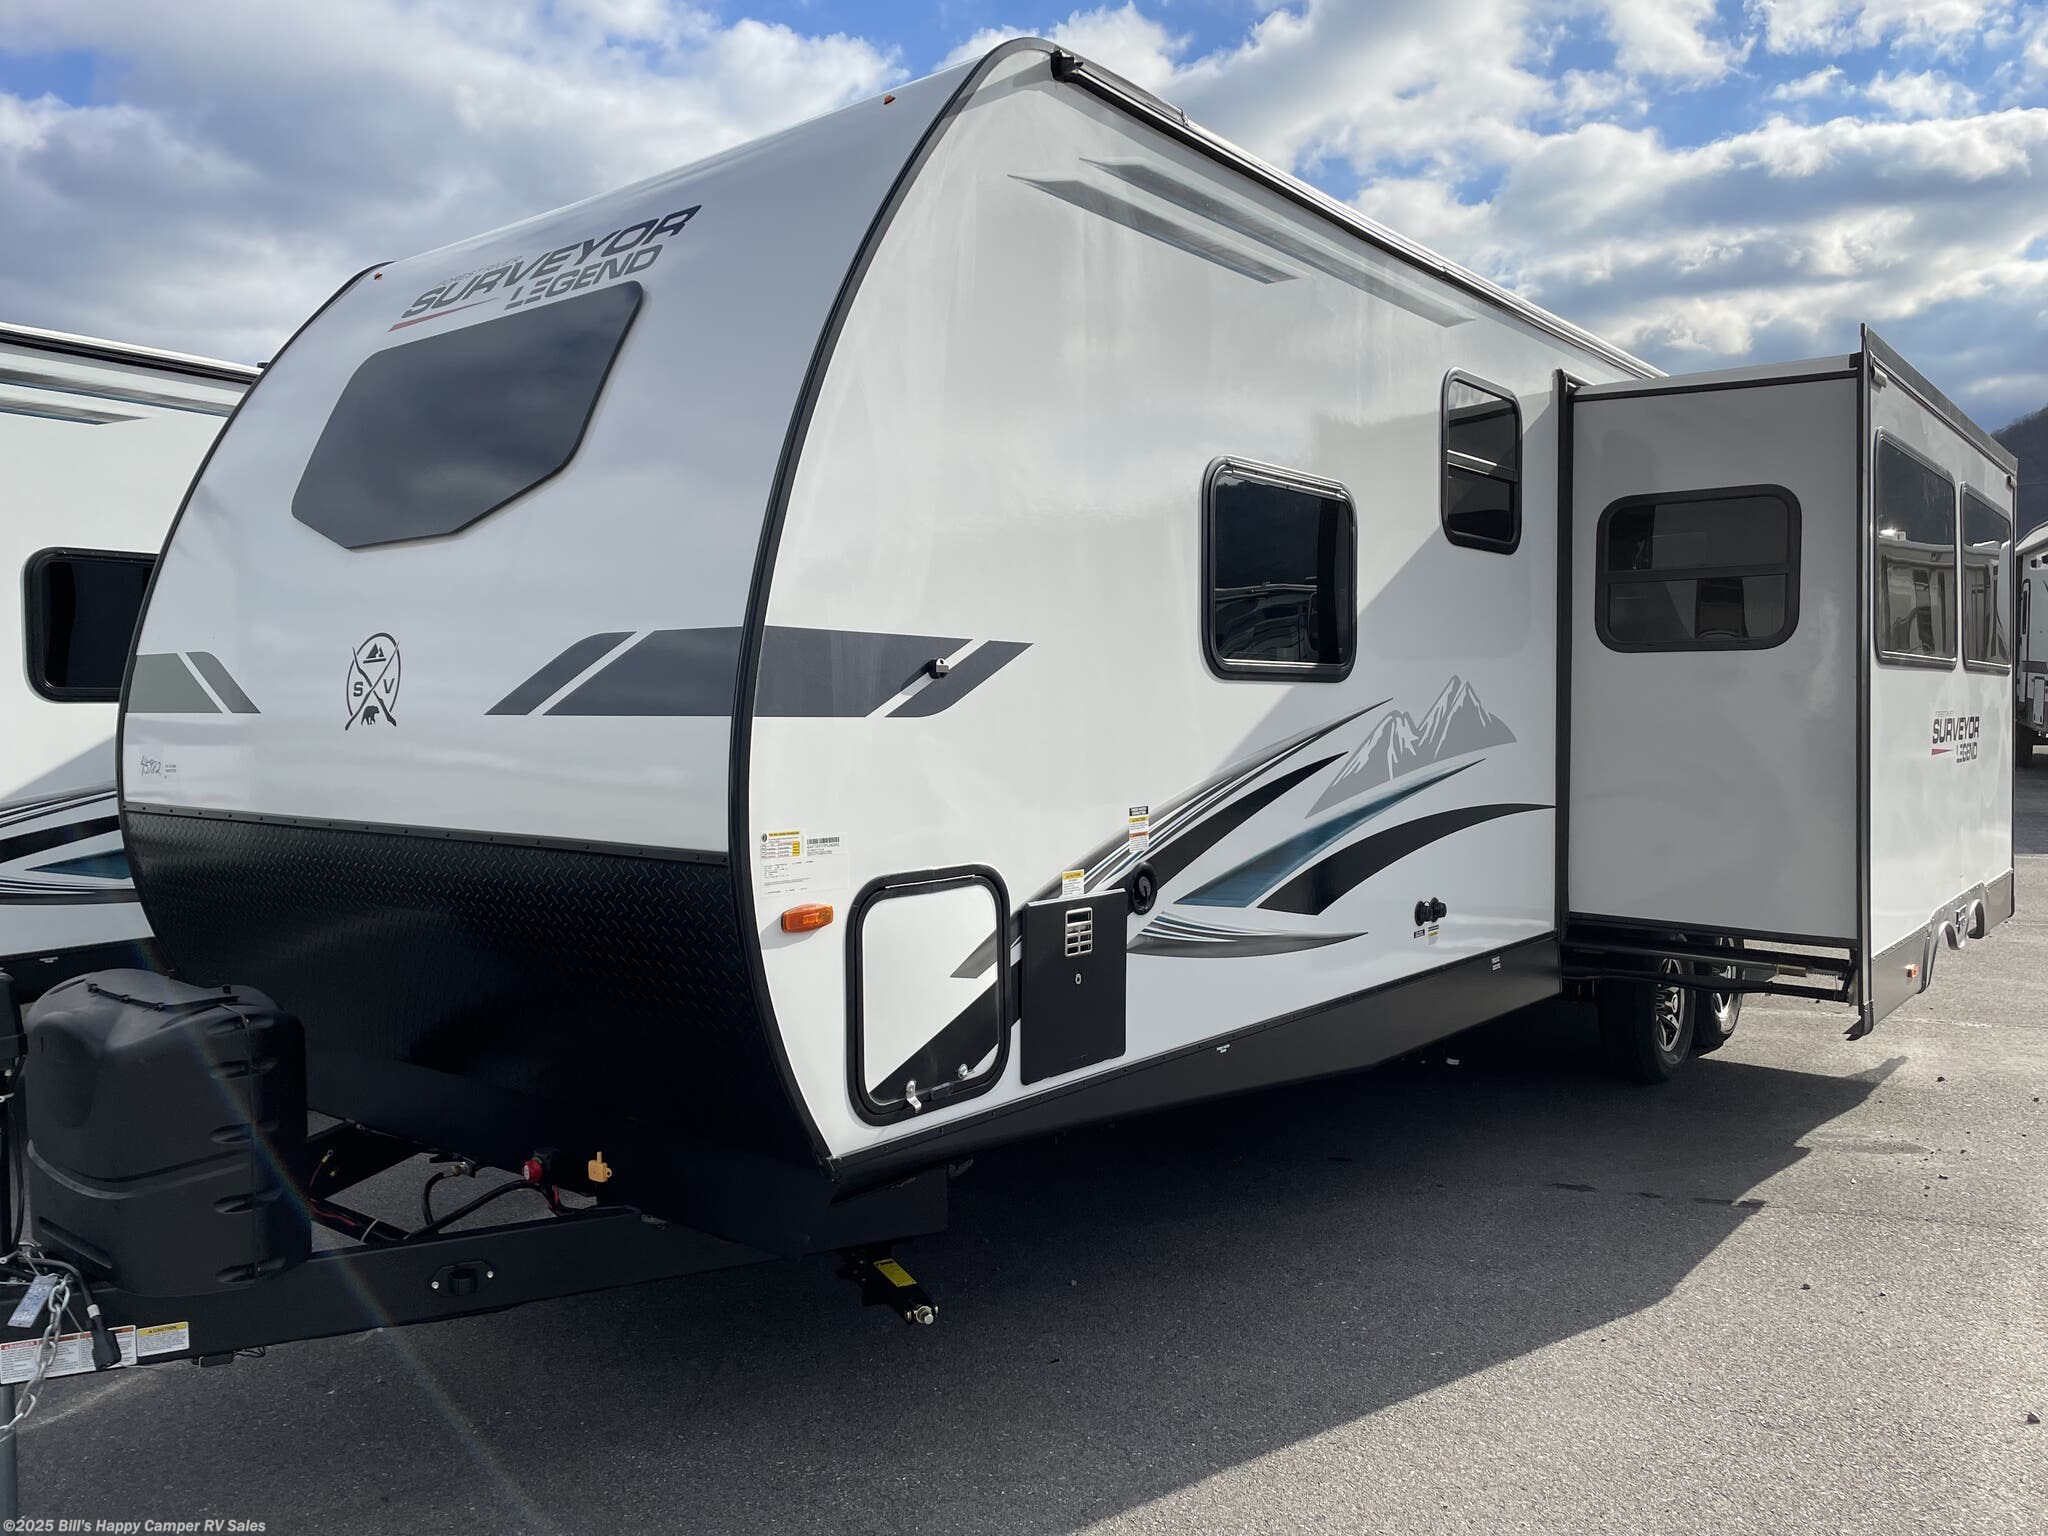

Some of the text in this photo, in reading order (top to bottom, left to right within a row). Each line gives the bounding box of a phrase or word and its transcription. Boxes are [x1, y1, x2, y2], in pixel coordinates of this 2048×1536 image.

[401, 204, 702, 319] SURVEYOR
[504, 243, 664, 311] LEGEND
[353, 677, 395, 697] S V
[1932, 716, 1980, 744] SURVEYOR
[1956, 742, 1978, 764] LEGEND
